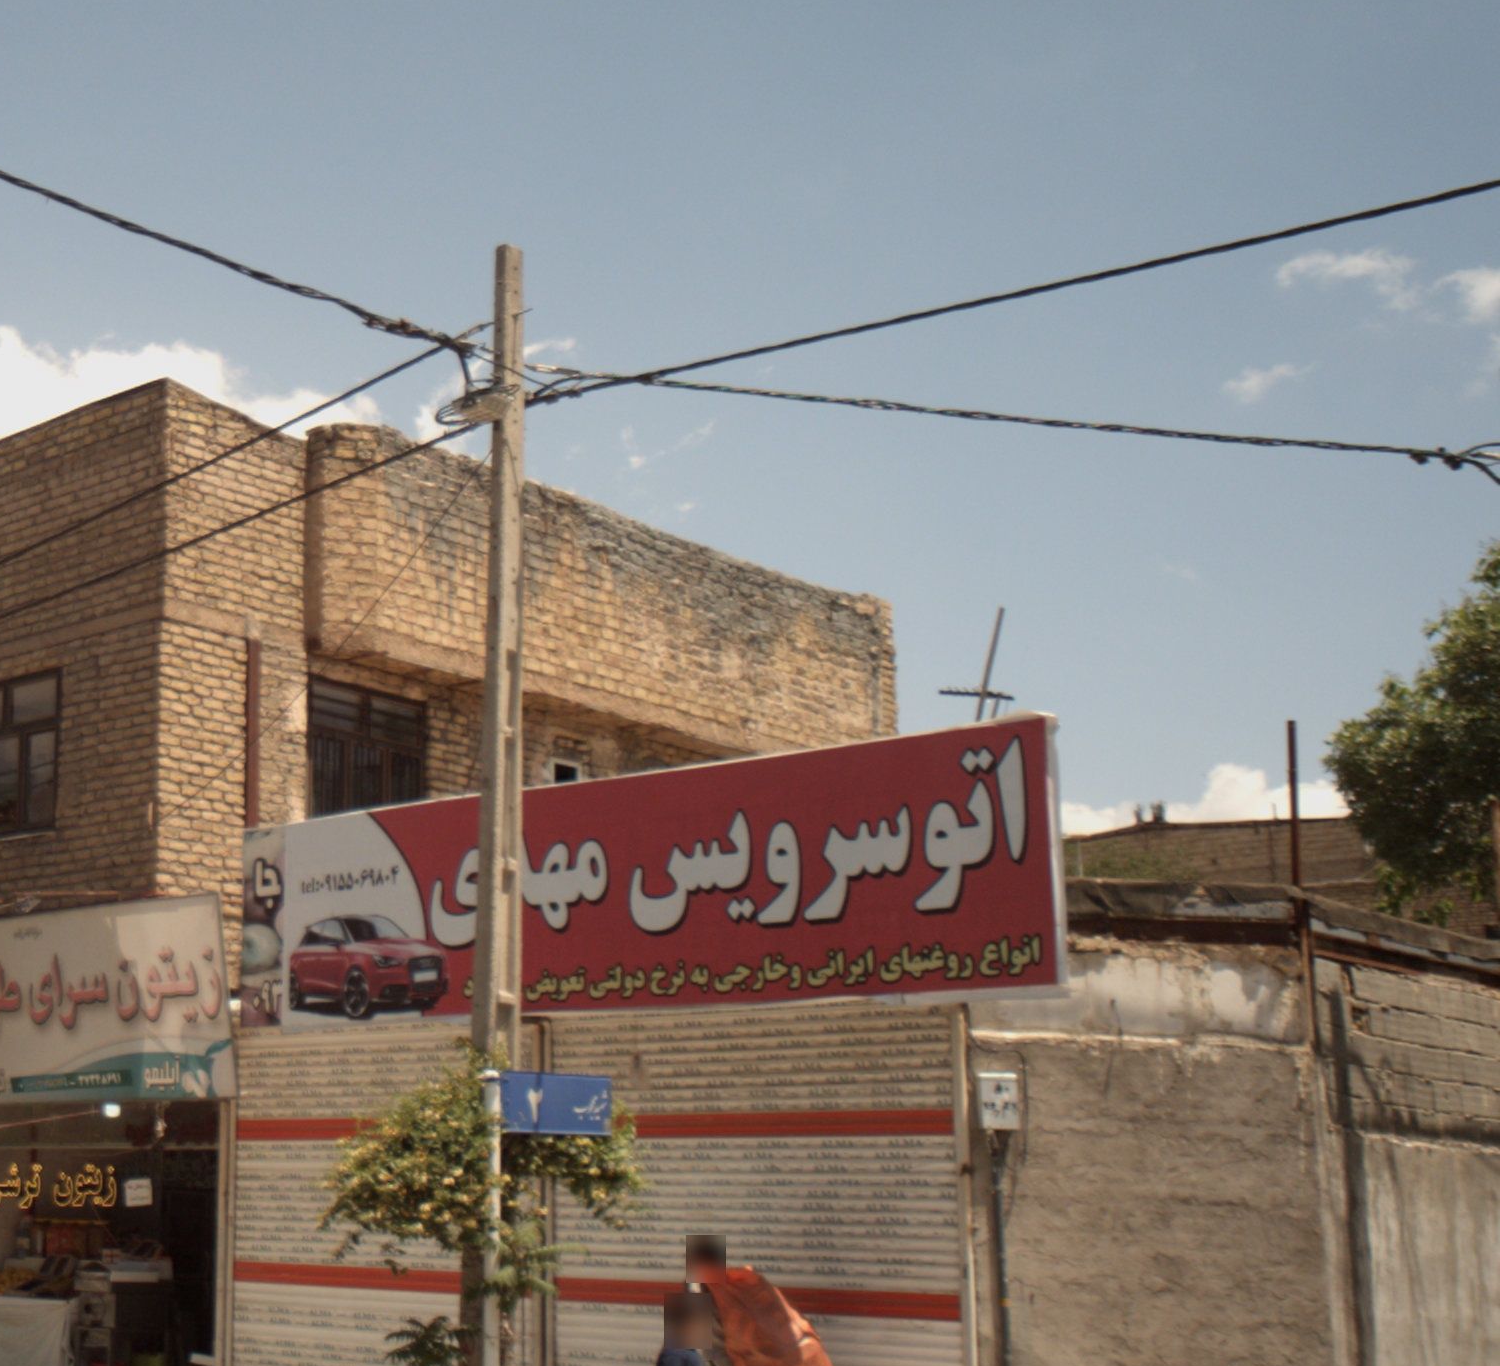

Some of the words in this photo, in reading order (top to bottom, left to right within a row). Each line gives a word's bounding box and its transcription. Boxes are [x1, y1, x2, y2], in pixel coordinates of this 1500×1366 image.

[806, 946, 875, 987] ایرانی
[879, 942, 973, 982] روغنهای
[978, 934, 1042, 977] انواع
[29, 953, 109, 1031] سرای
[115, 946, 222, 1023] زیتون
[524, 966, 587, 1002] تعویض
[589, 963, 647, 998] دولتی
[649, 958, 686, 996] نرخ
[690, 964, 710, 992] به
[53, 1163, 118, 1208] زیتون
